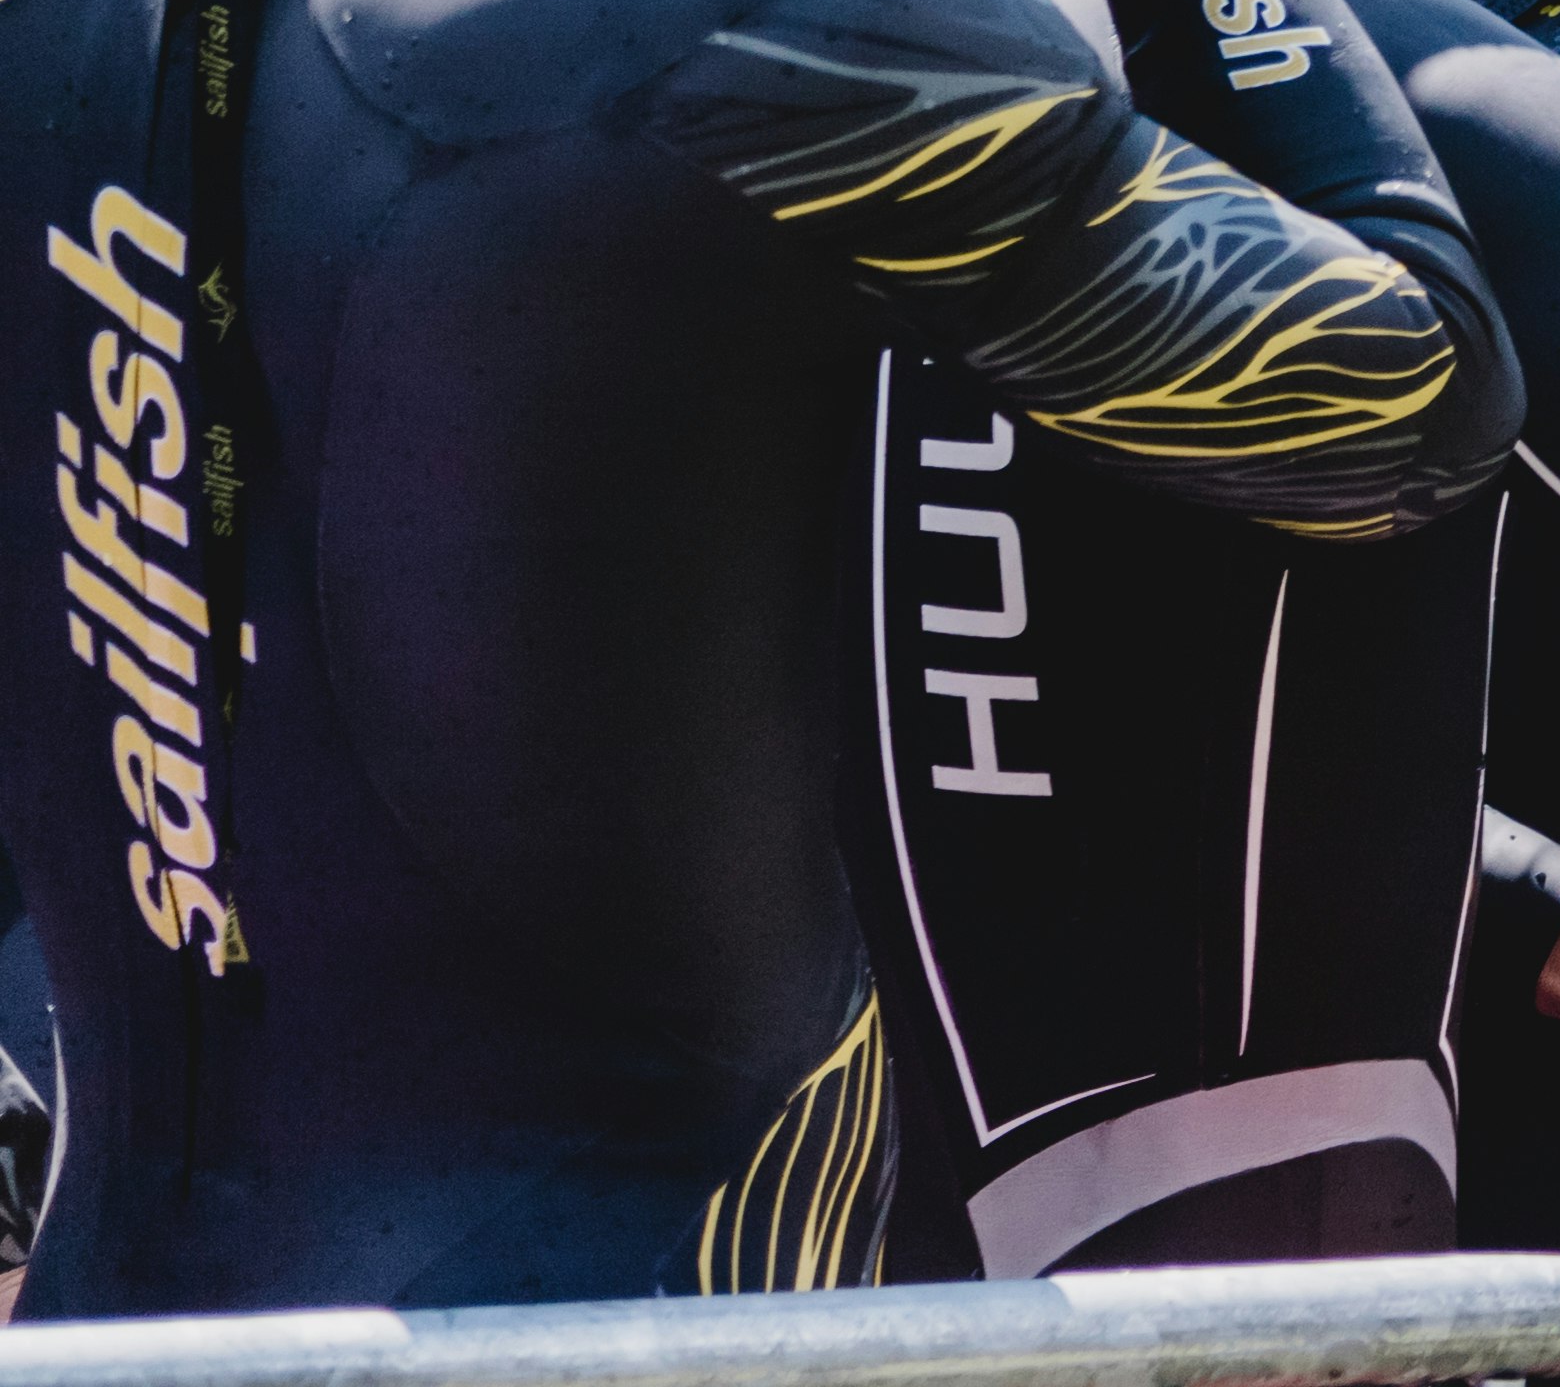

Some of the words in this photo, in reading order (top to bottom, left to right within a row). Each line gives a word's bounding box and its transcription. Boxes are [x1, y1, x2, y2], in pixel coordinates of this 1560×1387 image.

[204, 5, 230, 117] sailfish
[202, 425, 244, 536] sailfish
[47, 186, 256, 977] sailfish
